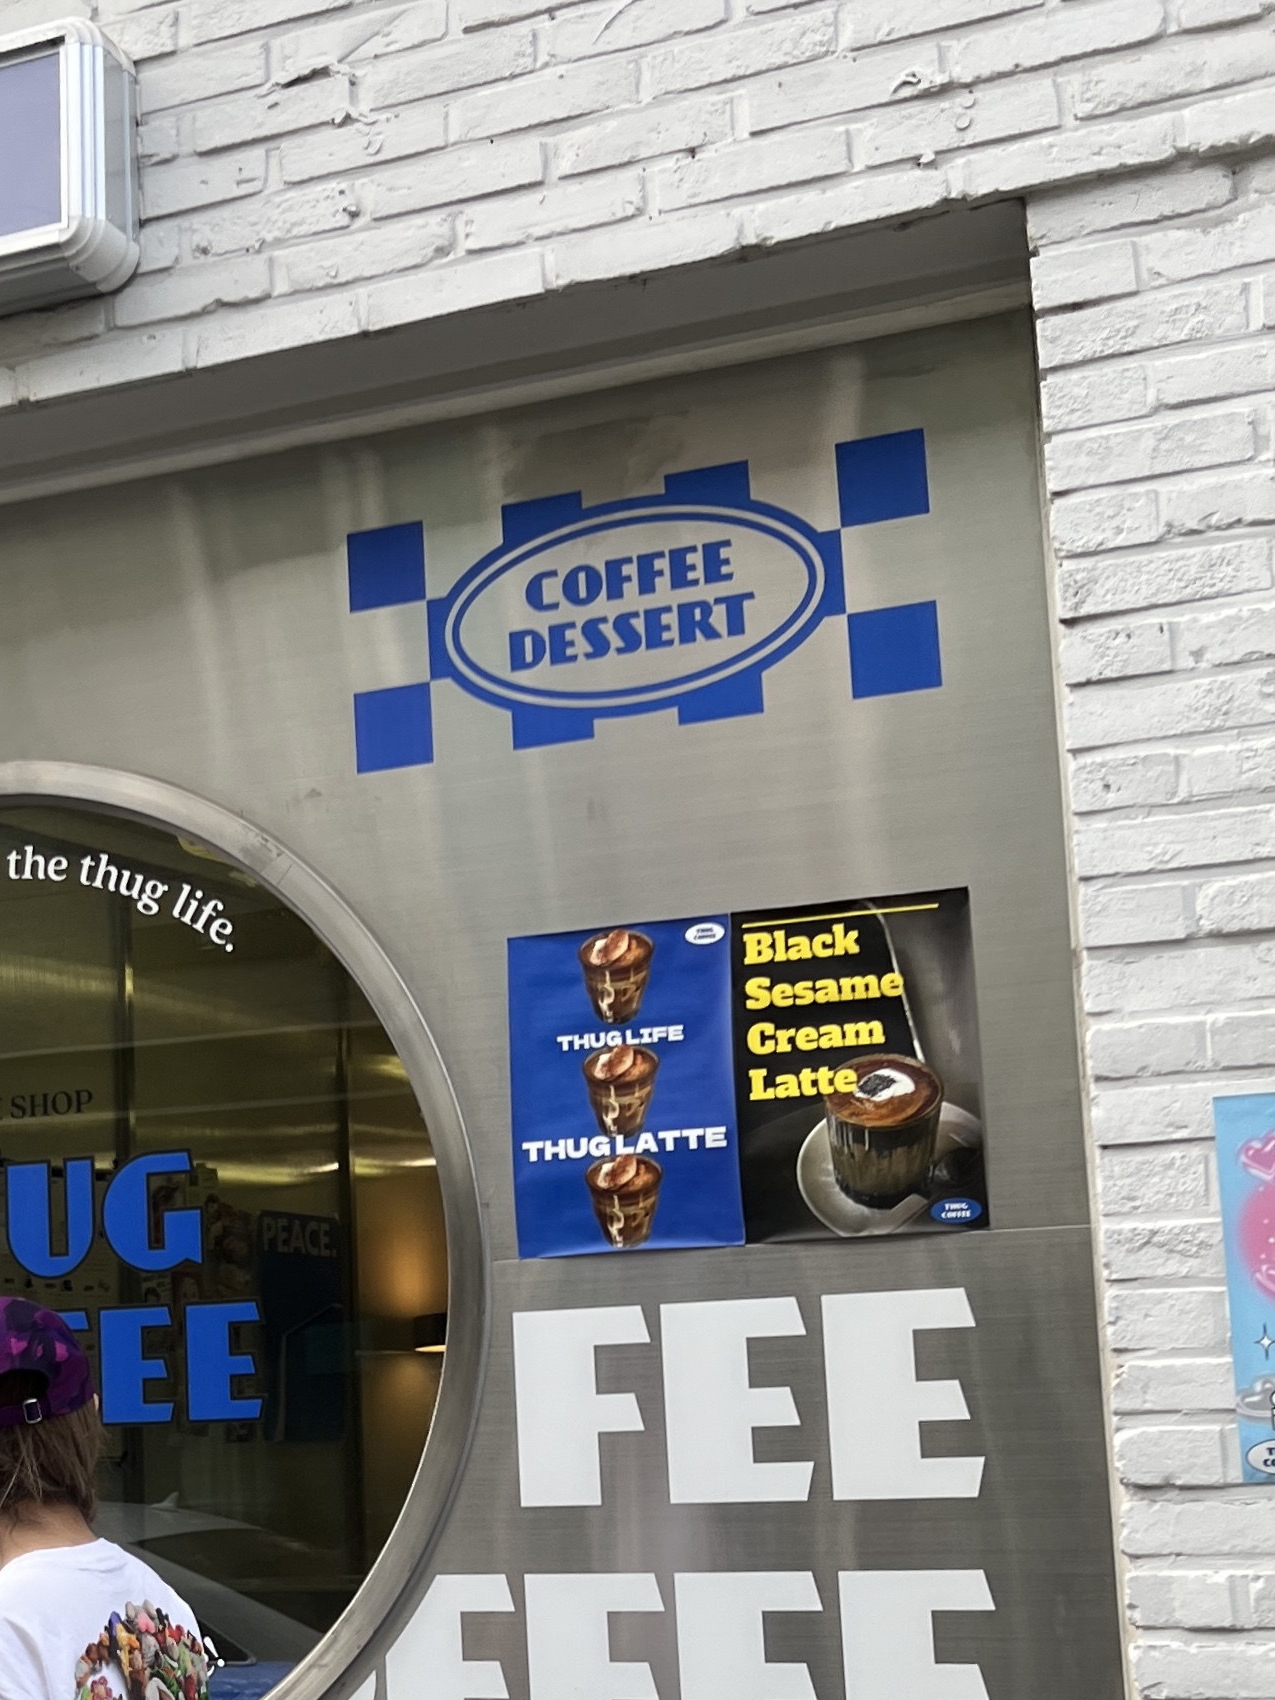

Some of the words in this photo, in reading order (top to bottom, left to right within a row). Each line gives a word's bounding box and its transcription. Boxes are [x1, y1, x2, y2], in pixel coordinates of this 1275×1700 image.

[525, 539, 735, 612] COFFEE
[509, 592, 756, 672] DESSERT
[6, 845, 69, 881] the
[79, 853, 169, 916] thug
[170, 884, 236, 953] life.
[742, 923, 860, 966] Black
[744, 970, 904, 1012] Sesame
[556, 1029, 623, 1051] THUG
[621, 1024, 684, 1044] LIFE
[746, 1019, 886, 1056] Cream
[10, 1088, 94, 1119] SHOP
[748, 1066, 859, 1101] Latte
[522, 1135, 611, 1163] THUG
[615, 1126, 729, 1155] LATTE
[261, 1214, 338, 1258] PEACE.
[512, 1286, 986, 1508] FEE
